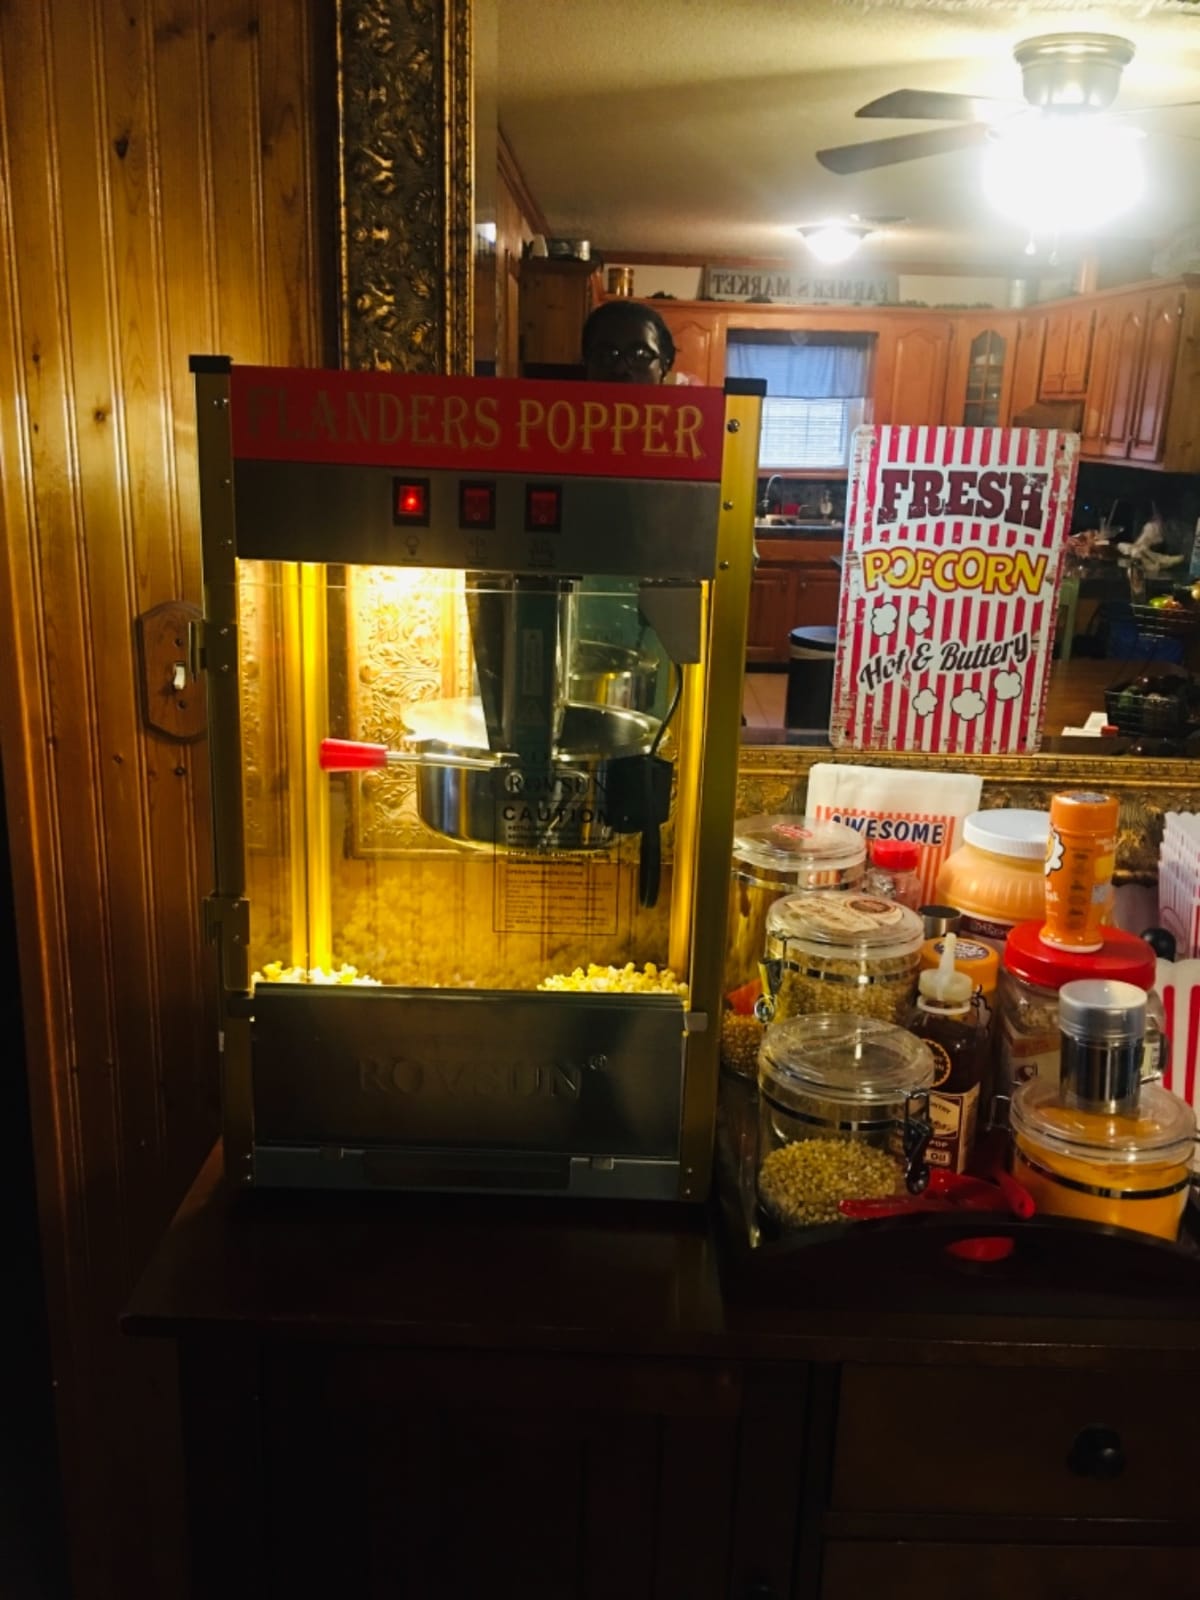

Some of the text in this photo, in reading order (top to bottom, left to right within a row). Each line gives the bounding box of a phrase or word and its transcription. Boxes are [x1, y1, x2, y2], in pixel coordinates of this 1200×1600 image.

[245, 384, 707, 461] FLANDERS POPPER
[877, 469, 1048, 530] FRESH
[862, 546, 1049, 595] POPCORN
[859, 632, 1029, 691] Hot & Buttery
[503, 806, 608, 823] CAUTION
